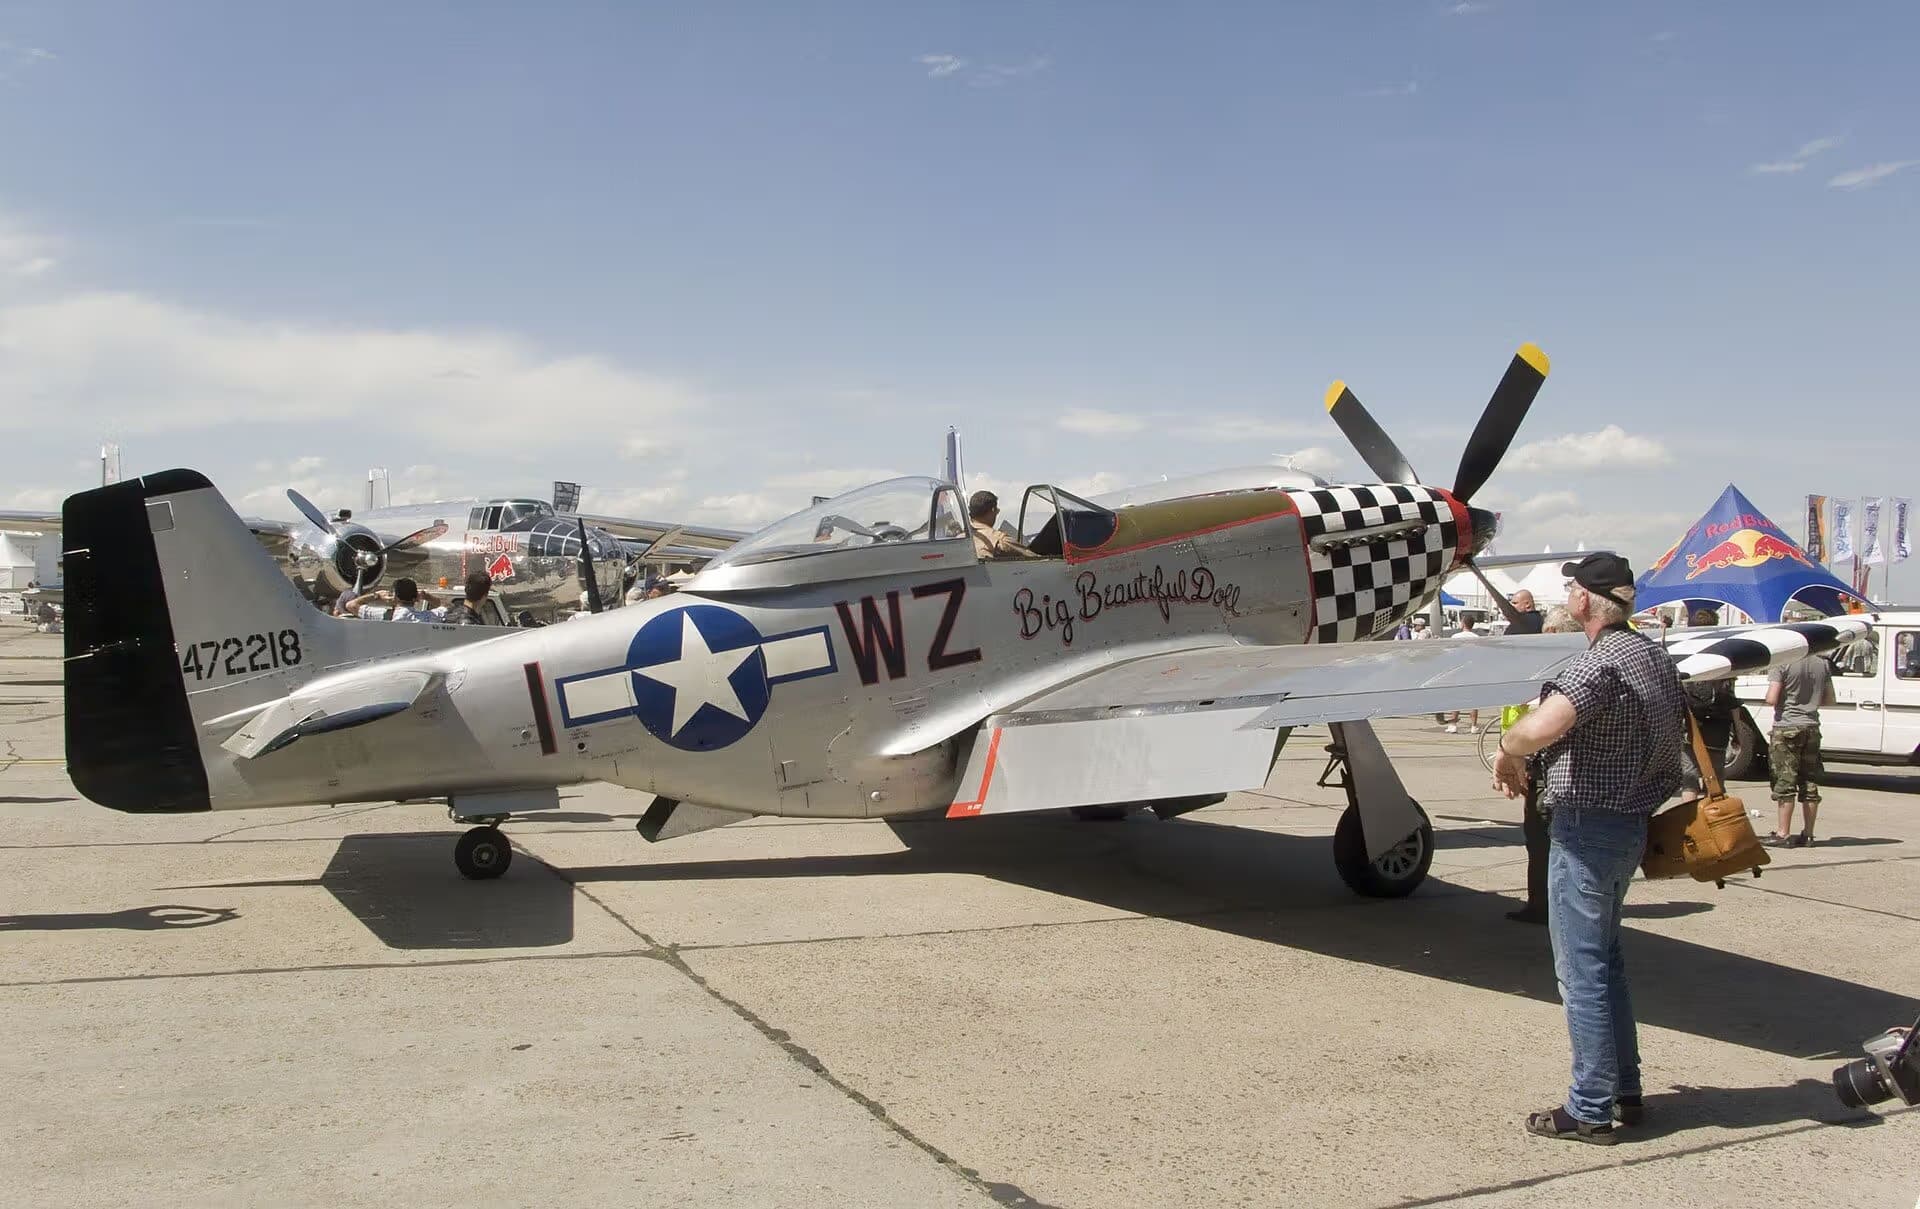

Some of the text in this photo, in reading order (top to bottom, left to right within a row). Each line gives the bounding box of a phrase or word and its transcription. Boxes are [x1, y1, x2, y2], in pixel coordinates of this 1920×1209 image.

[472, 533, 518, 553] Red Bull
[1705, 514, 1741, 538] Red
[833, 577, 983, 687] WZ
[1013, 565, 1242, 647] Big Beautiful Doll
[182, 629, 302, 681] 472218
